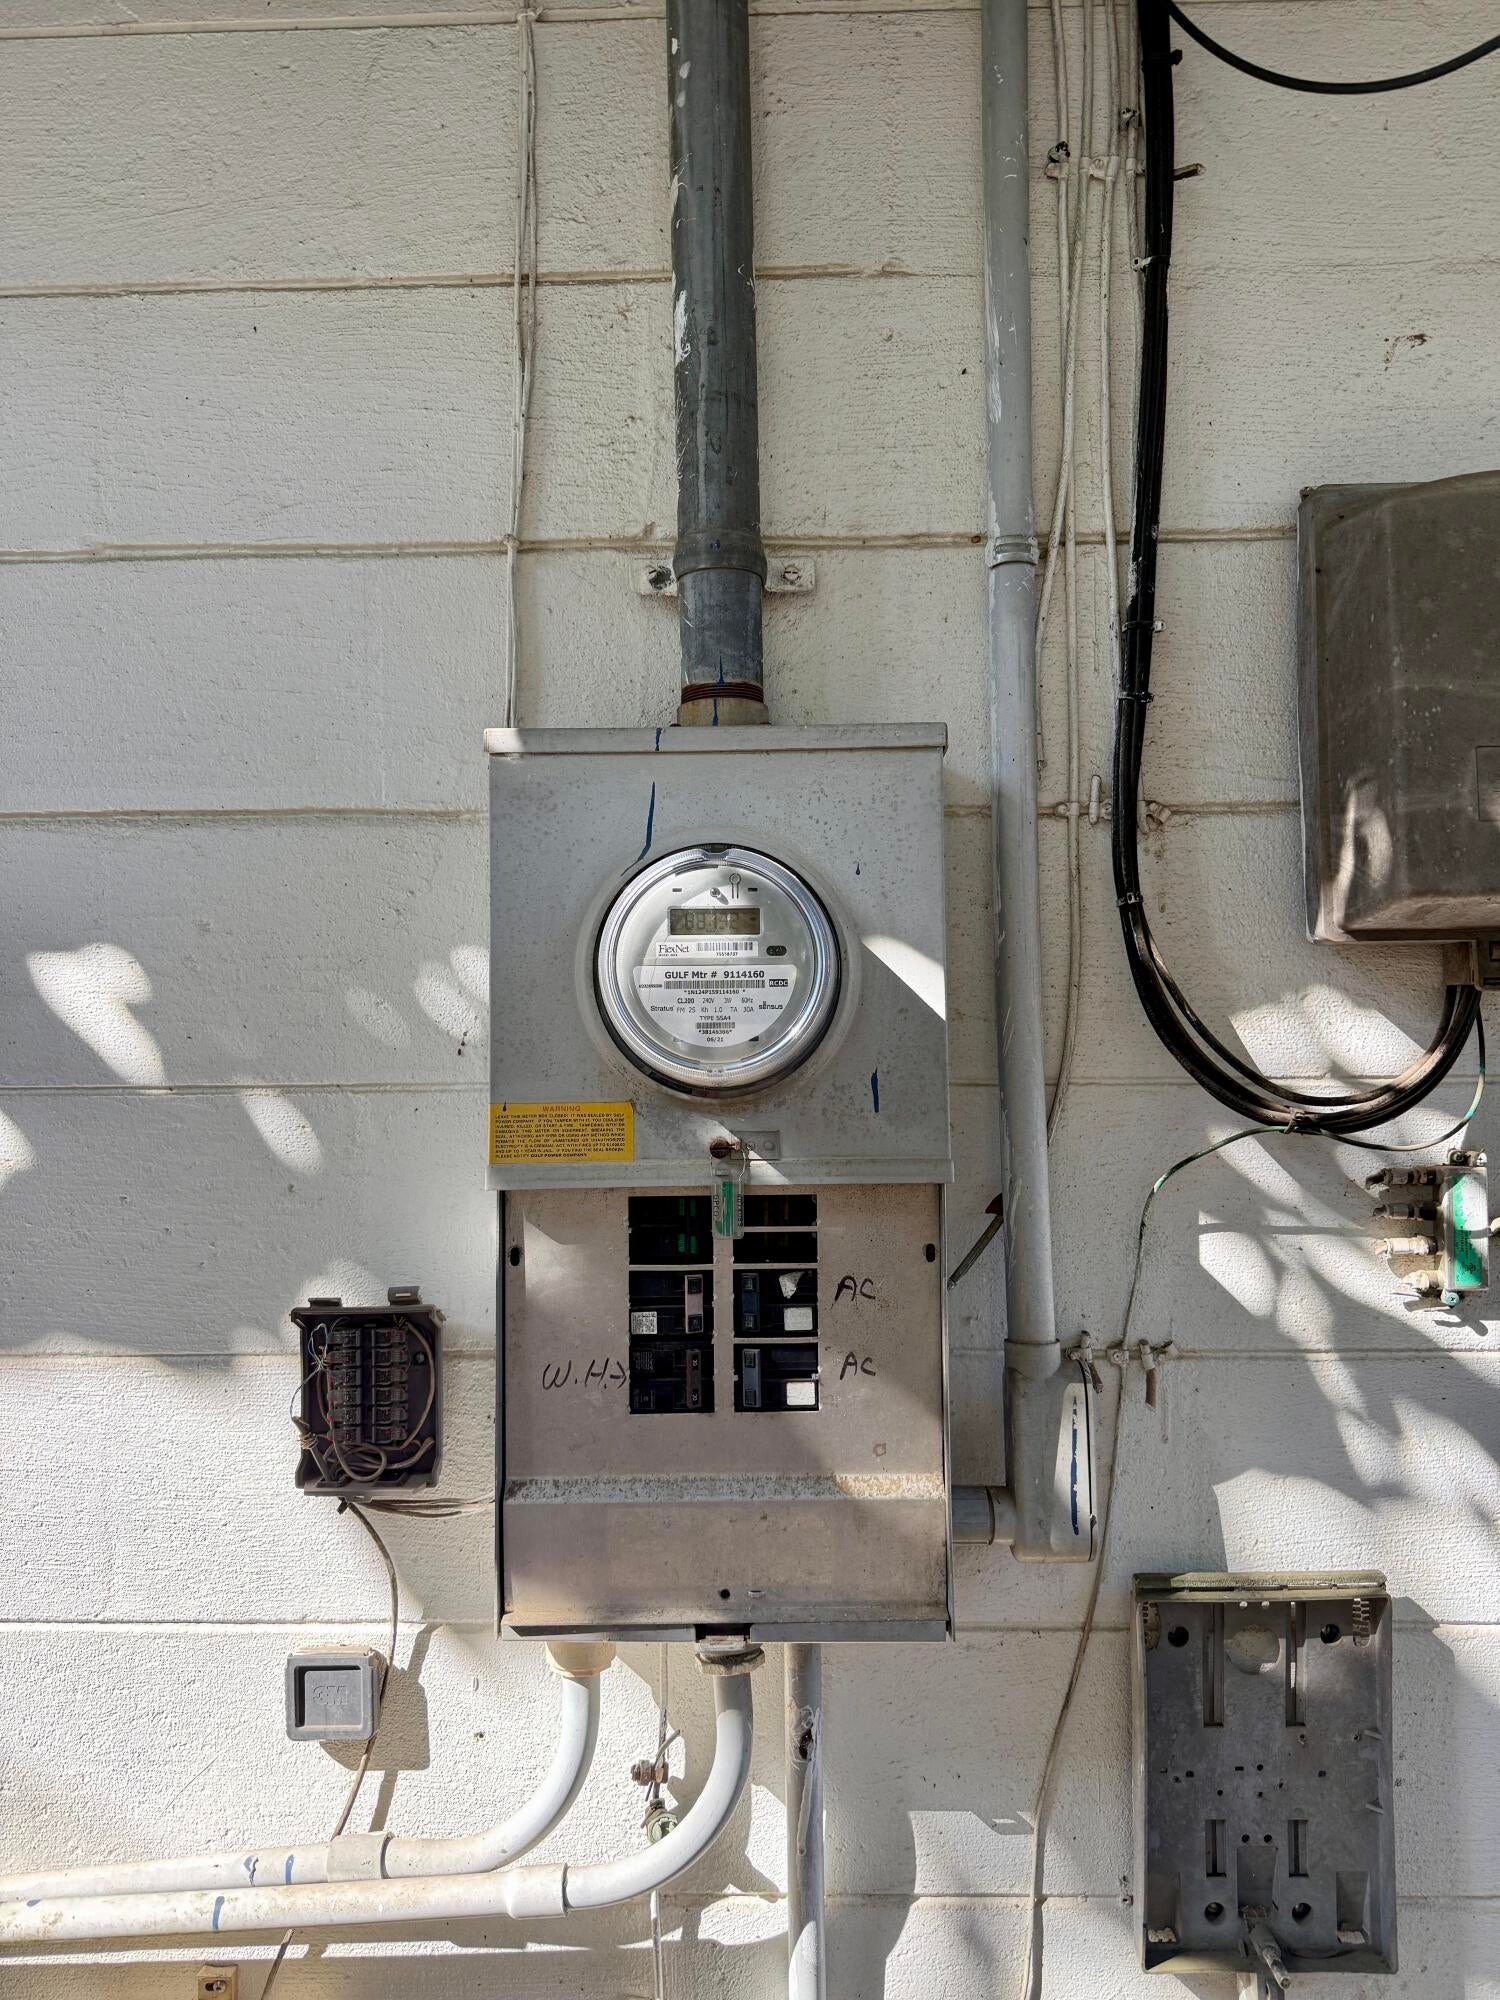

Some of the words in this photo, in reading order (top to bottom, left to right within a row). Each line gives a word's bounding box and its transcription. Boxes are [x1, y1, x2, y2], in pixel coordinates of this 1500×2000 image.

[658, 944, 690, 953] FlexNet
[664, 971, 689, 979] GULF
[692, 971, 708, 979] Mtr
[711, 971, 717, 979] #
[723, 970, 765, 979] 9114160
[758, 1000, 784, 1010] sensus
[832, 1275, 877, 1305] AC
[839, 1351, 877, 1380] AC
[312, 1685, 348, 1705] 3M
